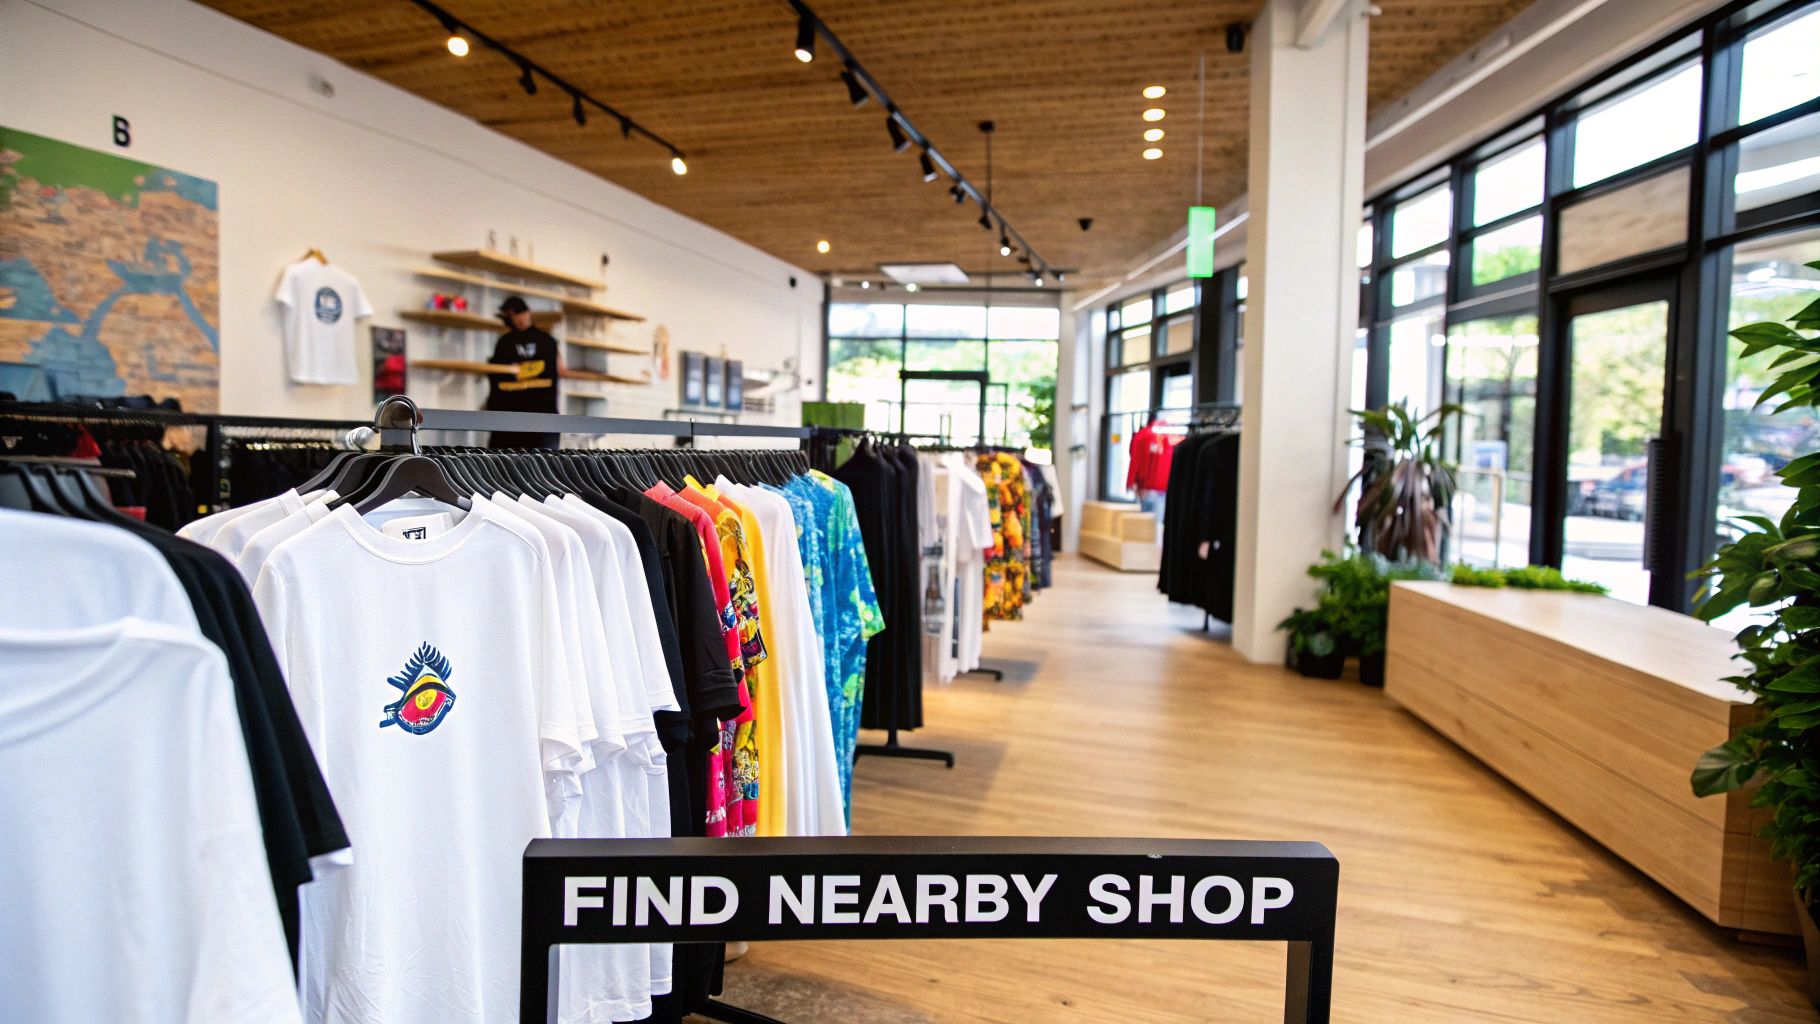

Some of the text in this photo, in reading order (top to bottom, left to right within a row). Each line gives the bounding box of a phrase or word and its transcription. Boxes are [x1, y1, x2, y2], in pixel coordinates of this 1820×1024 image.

[563, 873, 1295, 926] FIND NEARBY SHOP
